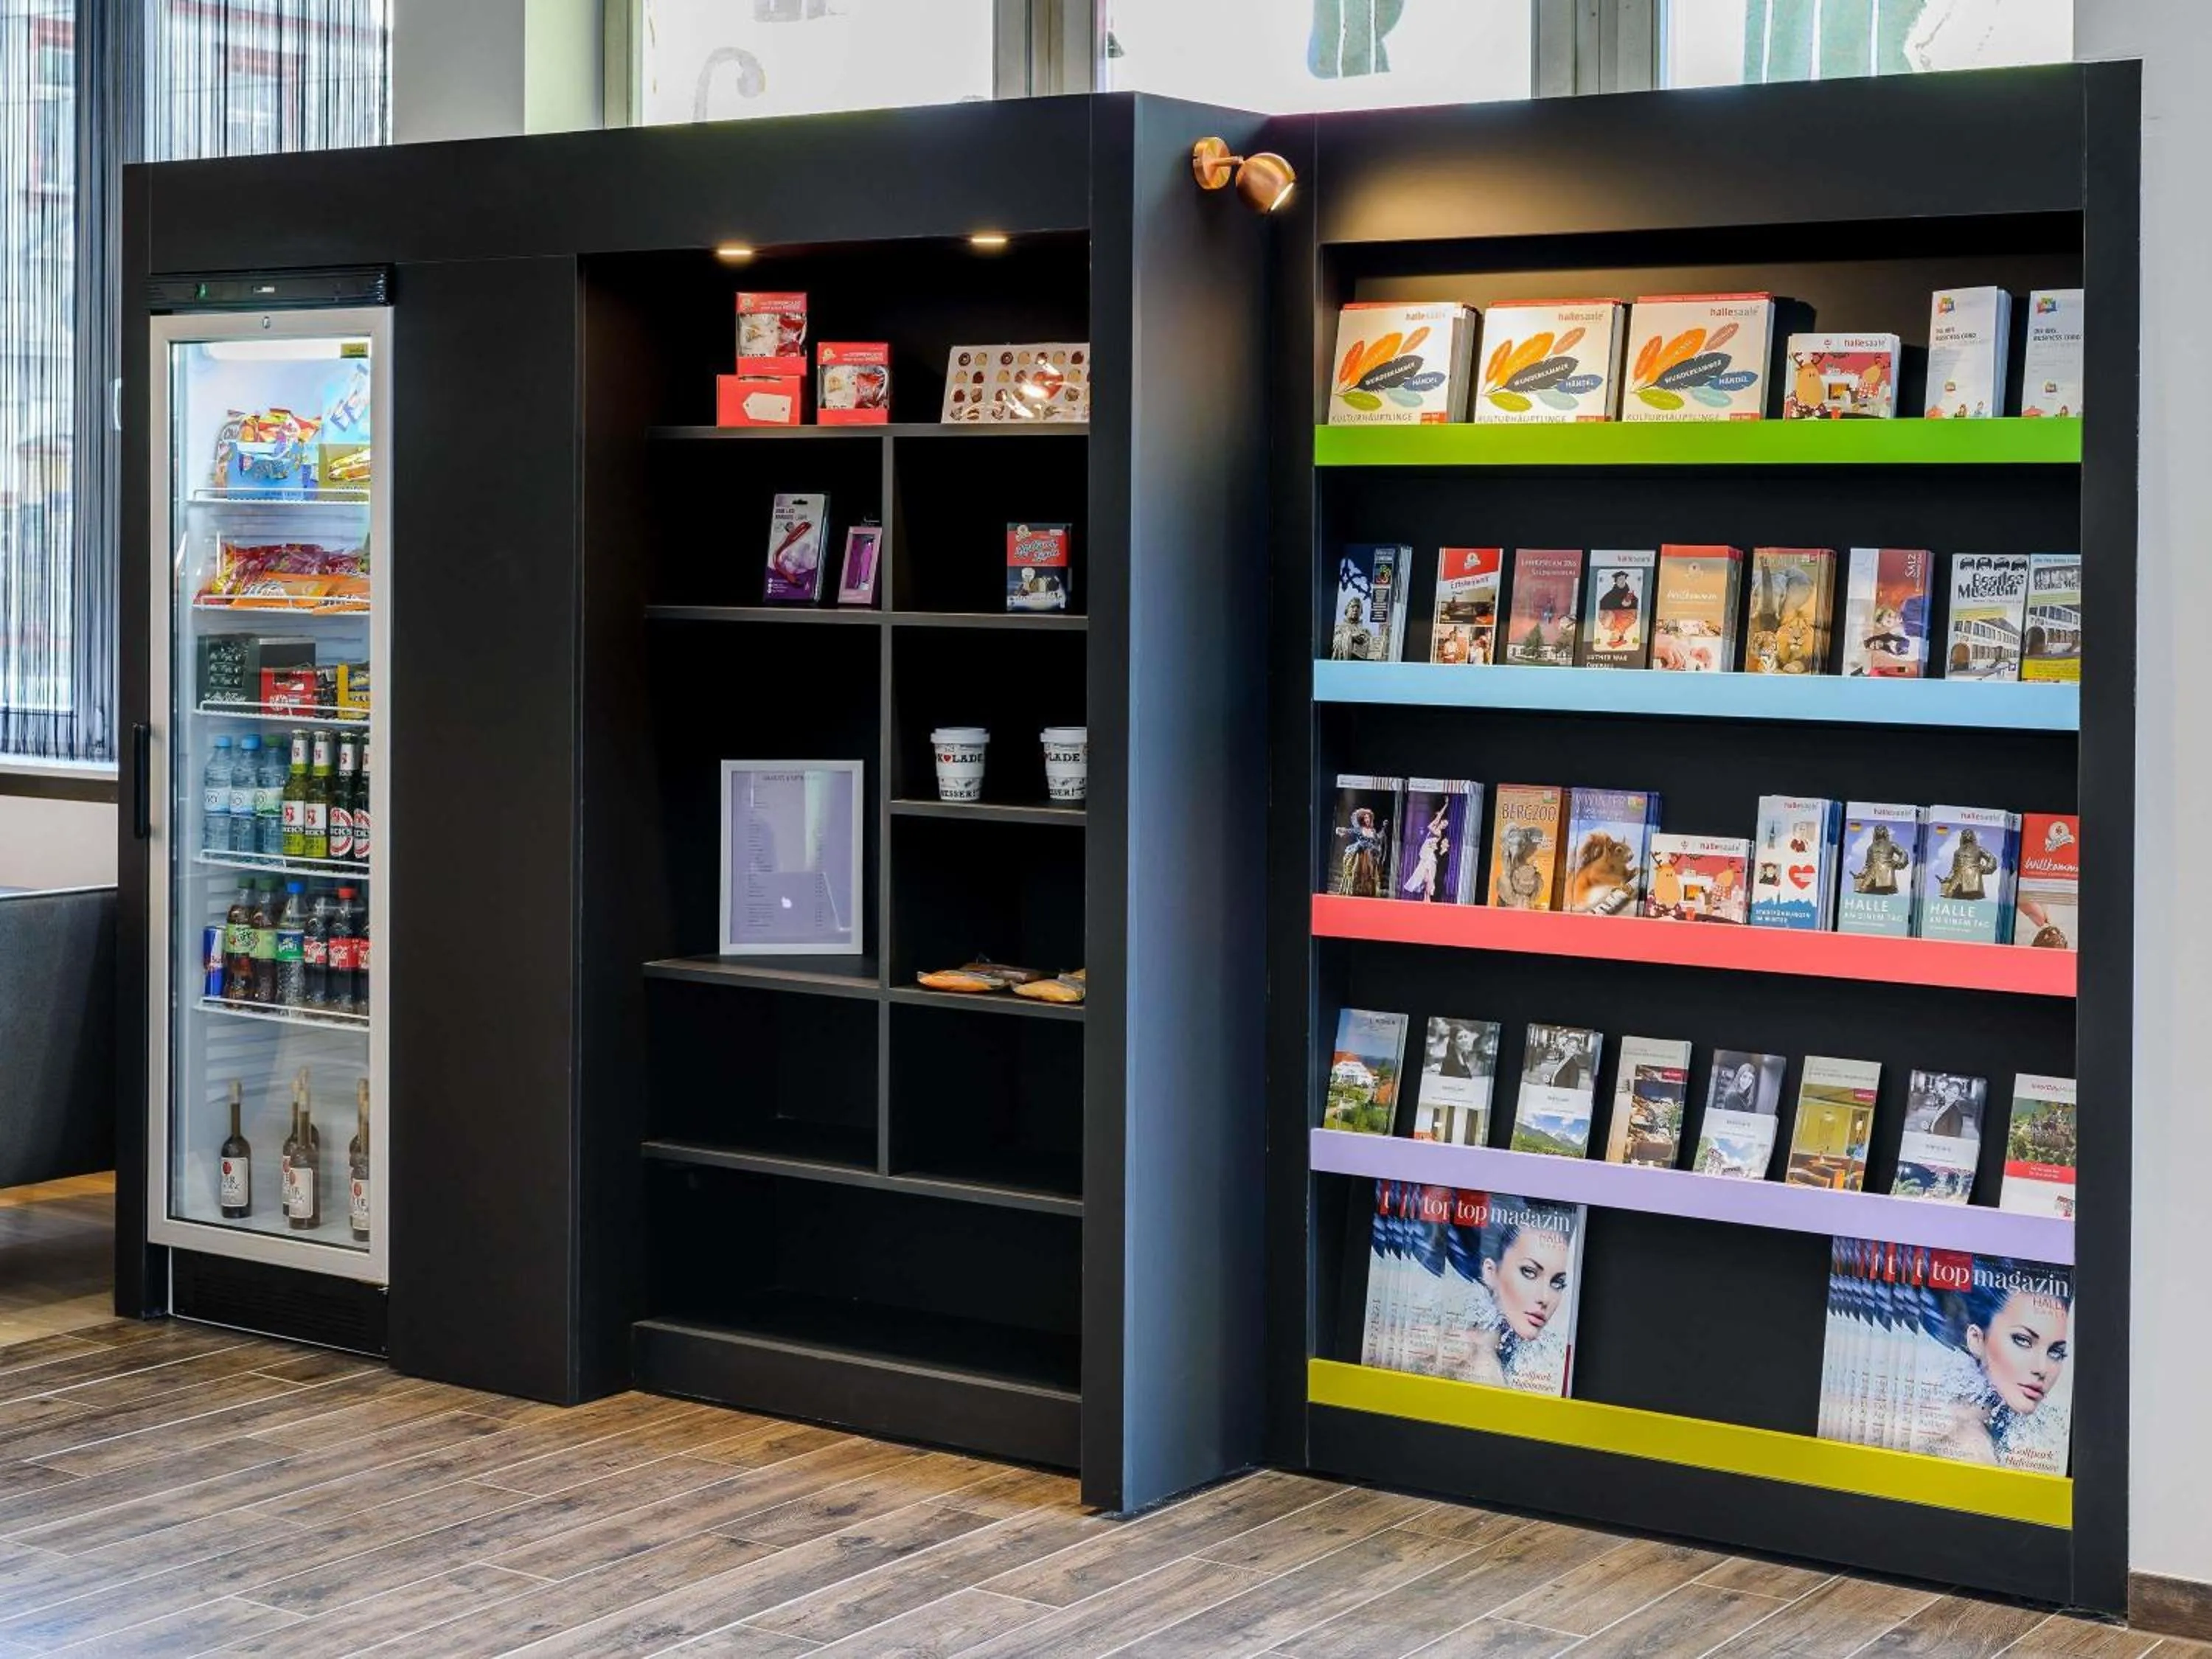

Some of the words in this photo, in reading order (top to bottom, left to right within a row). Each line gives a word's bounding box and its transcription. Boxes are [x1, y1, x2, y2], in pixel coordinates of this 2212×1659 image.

[1958, 583, 2018, 600] Museum
[1502, 802, 1557, 822] BERGZOO
[1844, 898, 1889, 913] HALLE
[1930, 903, 1977, 917] HALLE
[1456, 1200, 1488, 1224] top
[1490, 1206, 1571, 1232] magazin
[1932, 1259, 1969, 1287] top
[1974, 1270, 2069, 1298] magazin
